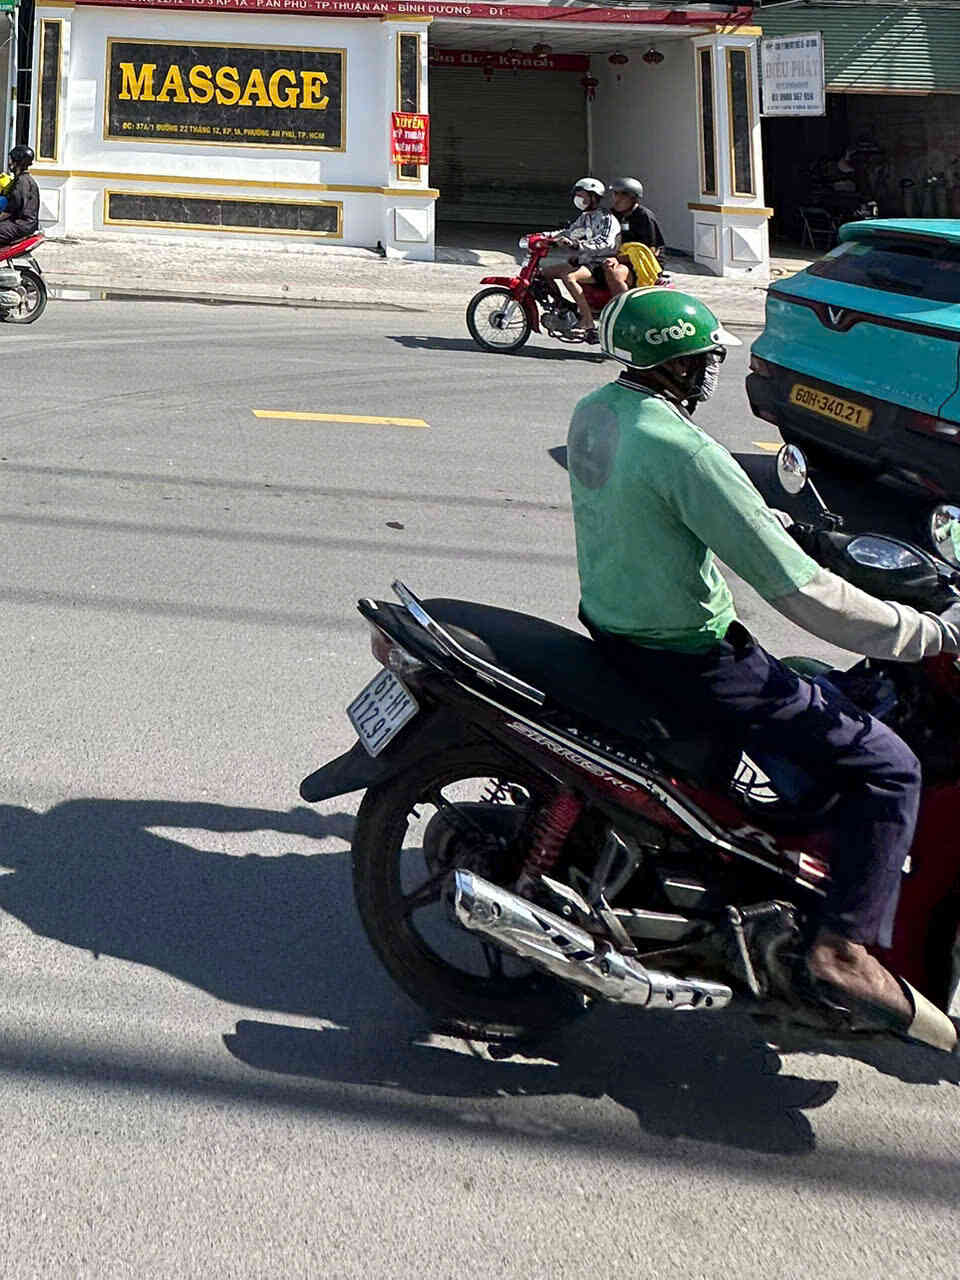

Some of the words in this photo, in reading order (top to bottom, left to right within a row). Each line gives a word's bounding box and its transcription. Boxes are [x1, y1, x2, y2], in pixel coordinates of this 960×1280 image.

[372, 3, 388, 11] AN
[119, 62, 329, 110] MASSAGE
[645, 318, 696, 345] Grab
[795, 387, 862, 424] 60H-340.21
